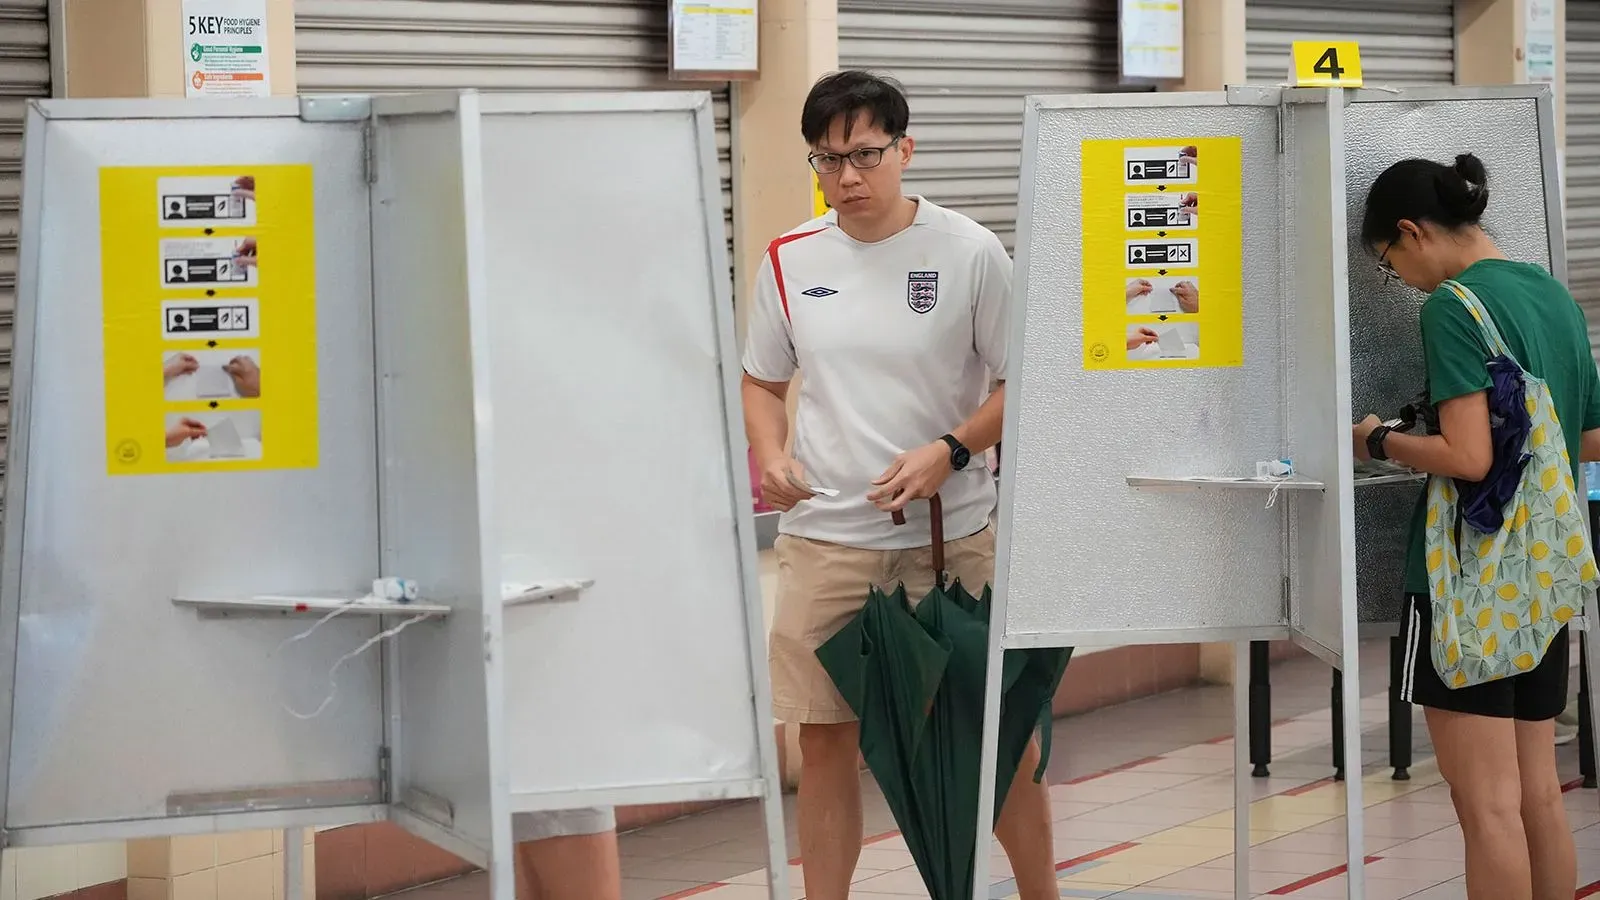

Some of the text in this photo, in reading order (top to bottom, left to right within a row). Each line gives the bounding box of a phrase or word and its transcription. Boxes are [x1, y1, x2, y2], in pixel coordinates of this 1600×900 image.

[189, 16, 223, 35] 5 KEY
[224, 18, 261, 26] FOOD HYGIENE
[224, 26, 252, 35] PRINCIPLES
[1313, 48, 1344, 80] 4
